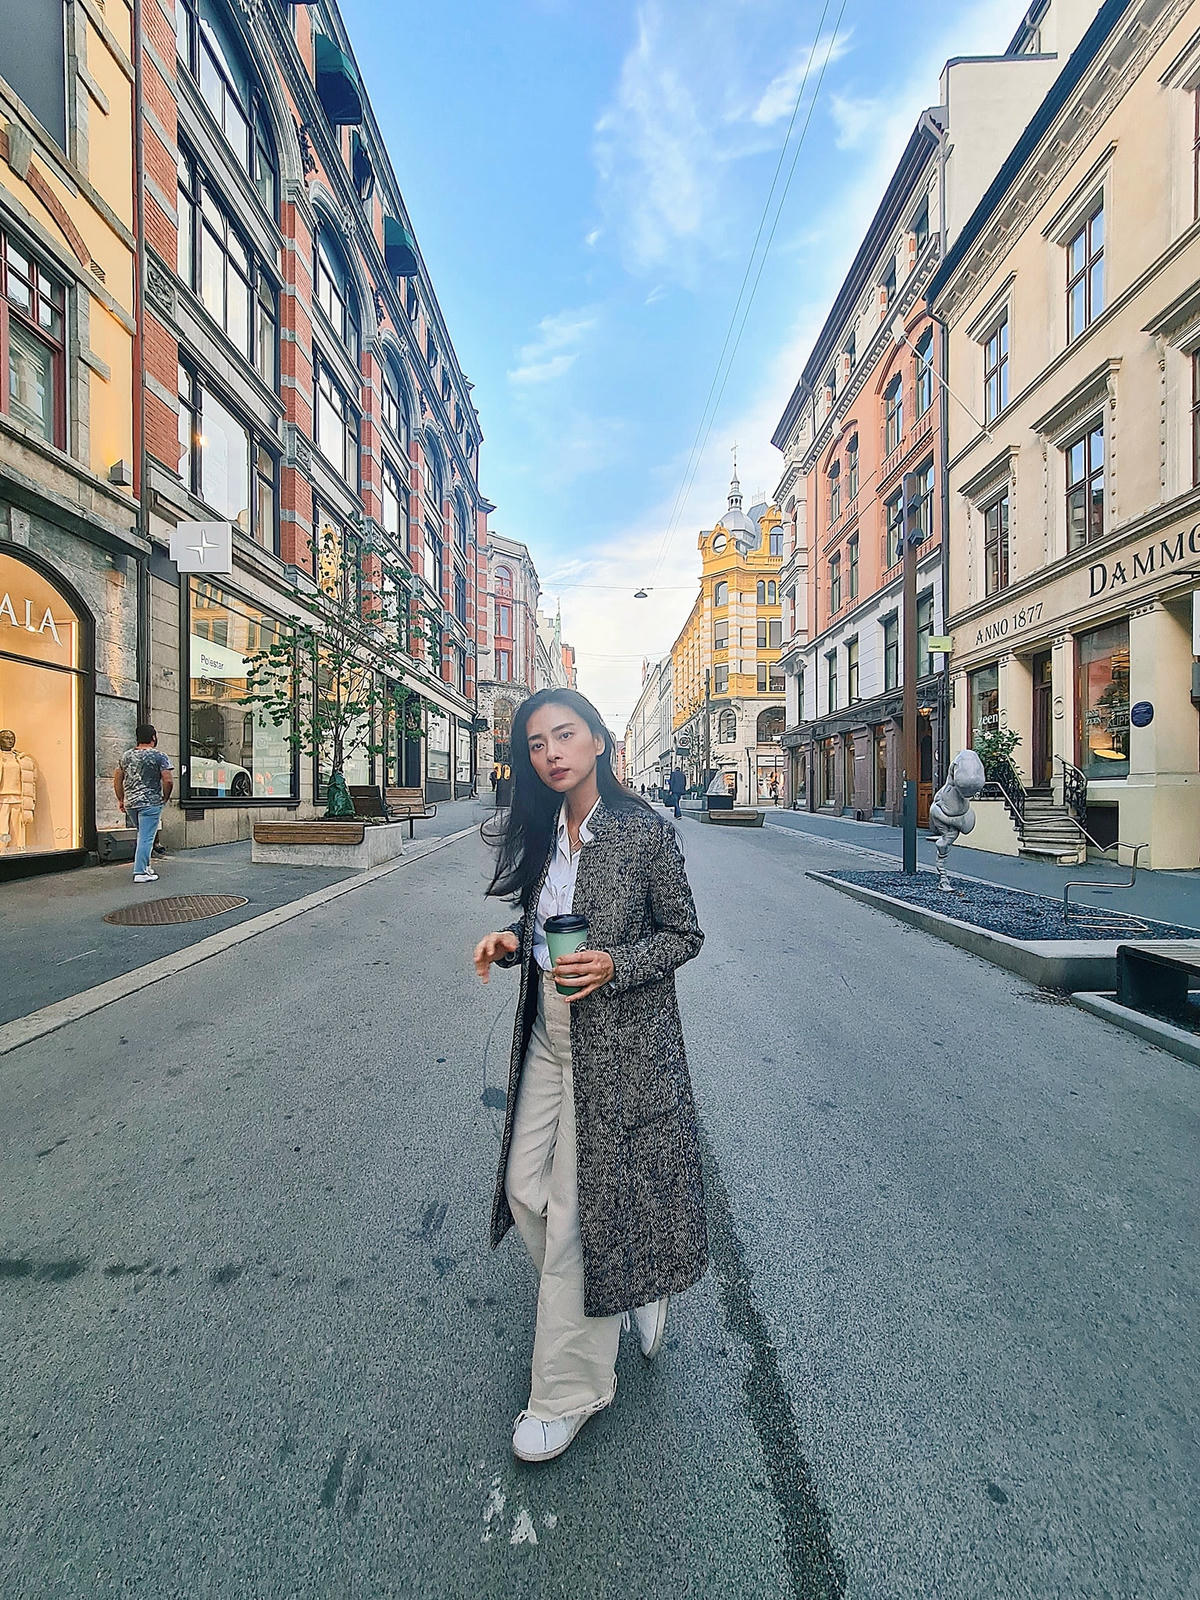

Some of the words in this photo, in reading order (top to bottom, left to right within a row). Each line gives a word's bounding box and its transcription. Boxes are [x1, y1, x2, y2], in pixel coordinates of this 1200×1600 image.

[975, 618, 1009, 646] ANNO
[1012, 602, 1044, 630] 1877
[200, 653, 224, 671] Polestar
